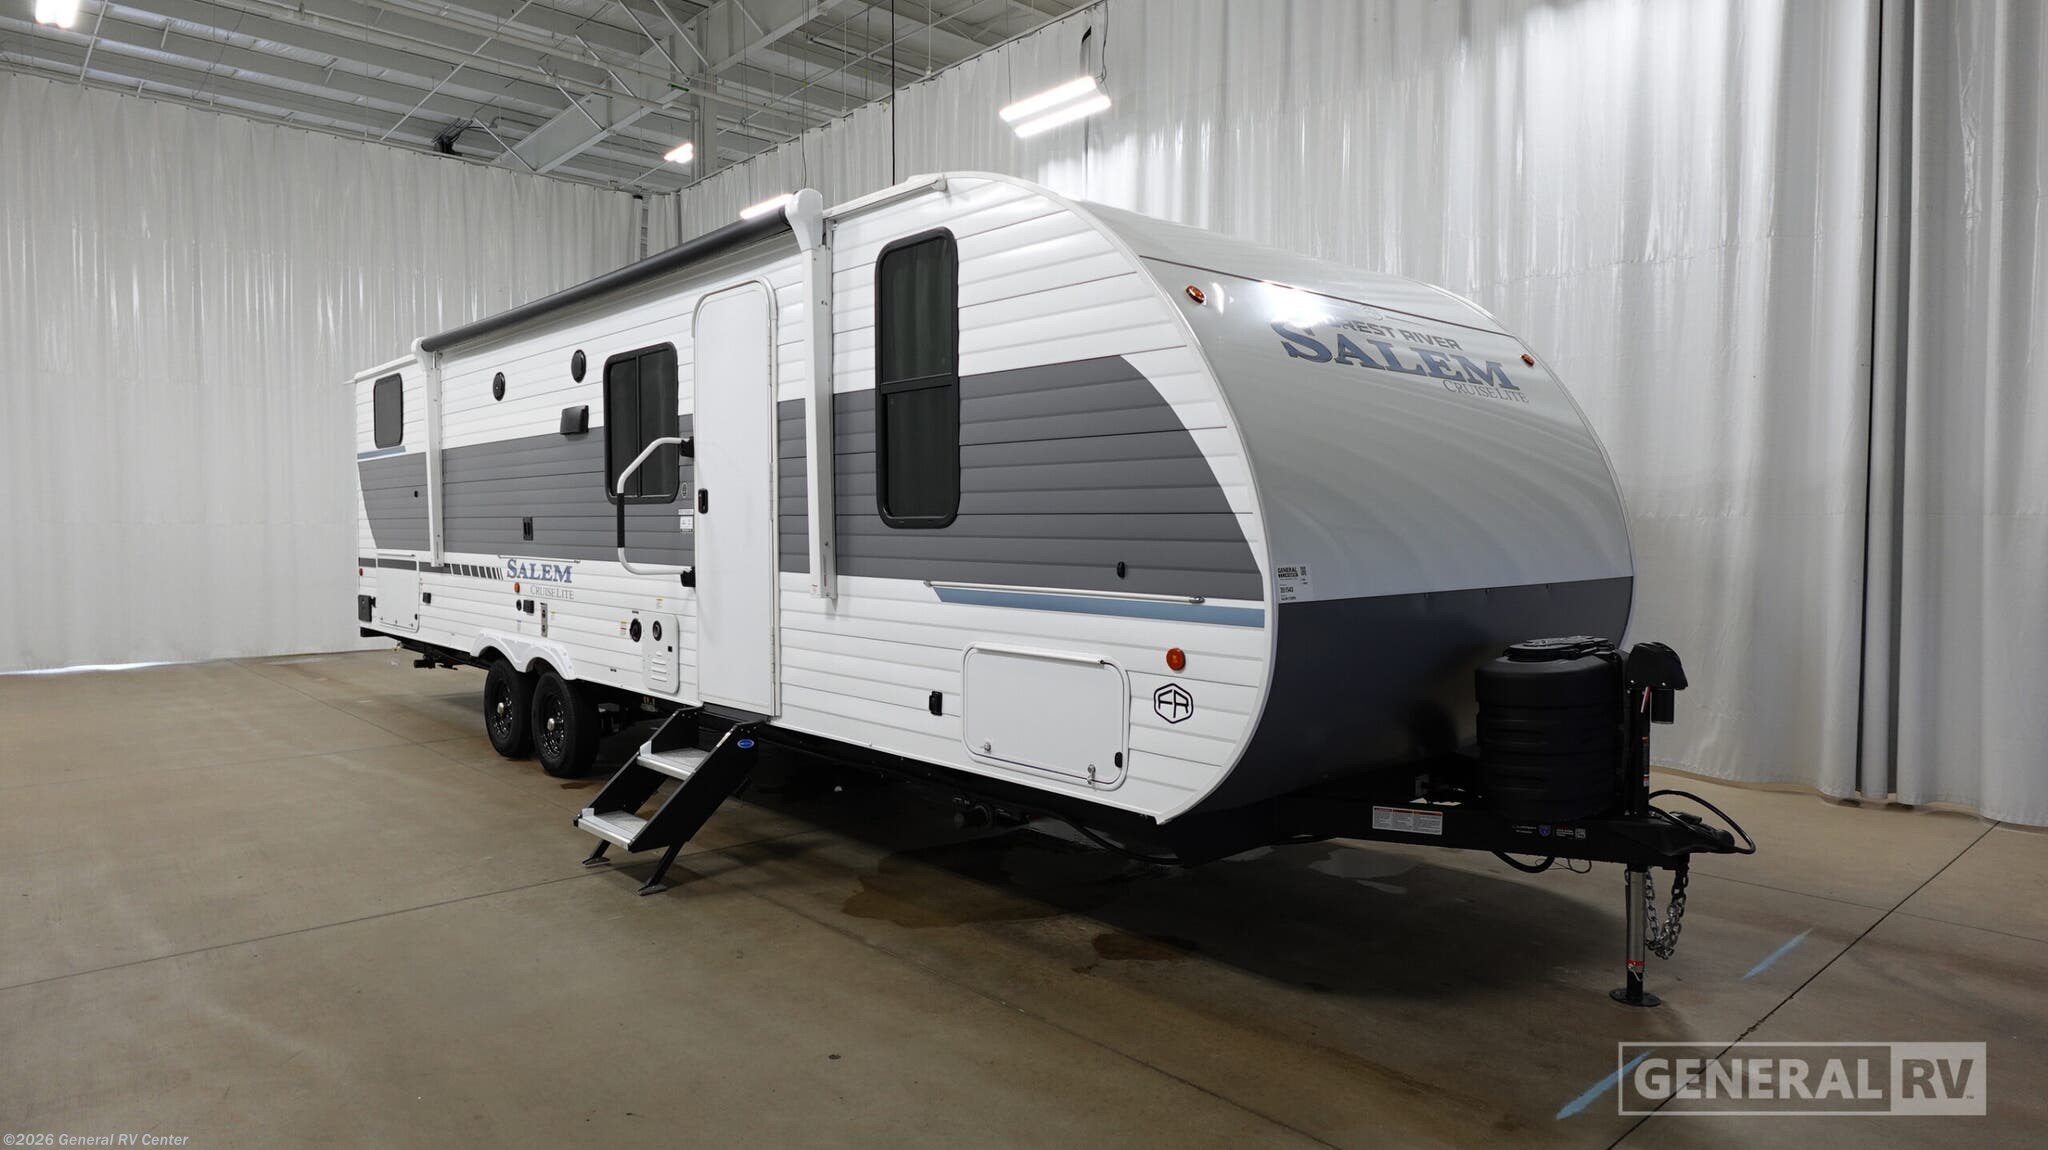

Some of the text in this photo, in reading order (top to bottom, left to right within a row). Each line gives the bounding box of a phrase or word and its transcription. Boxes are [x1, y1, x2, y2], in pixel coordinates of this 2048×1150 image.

[1396, 328, 1463, 352] RIVER
[1271, 320, 1520, 391] SALEM
[507, 558, 573, 583] SALEM
